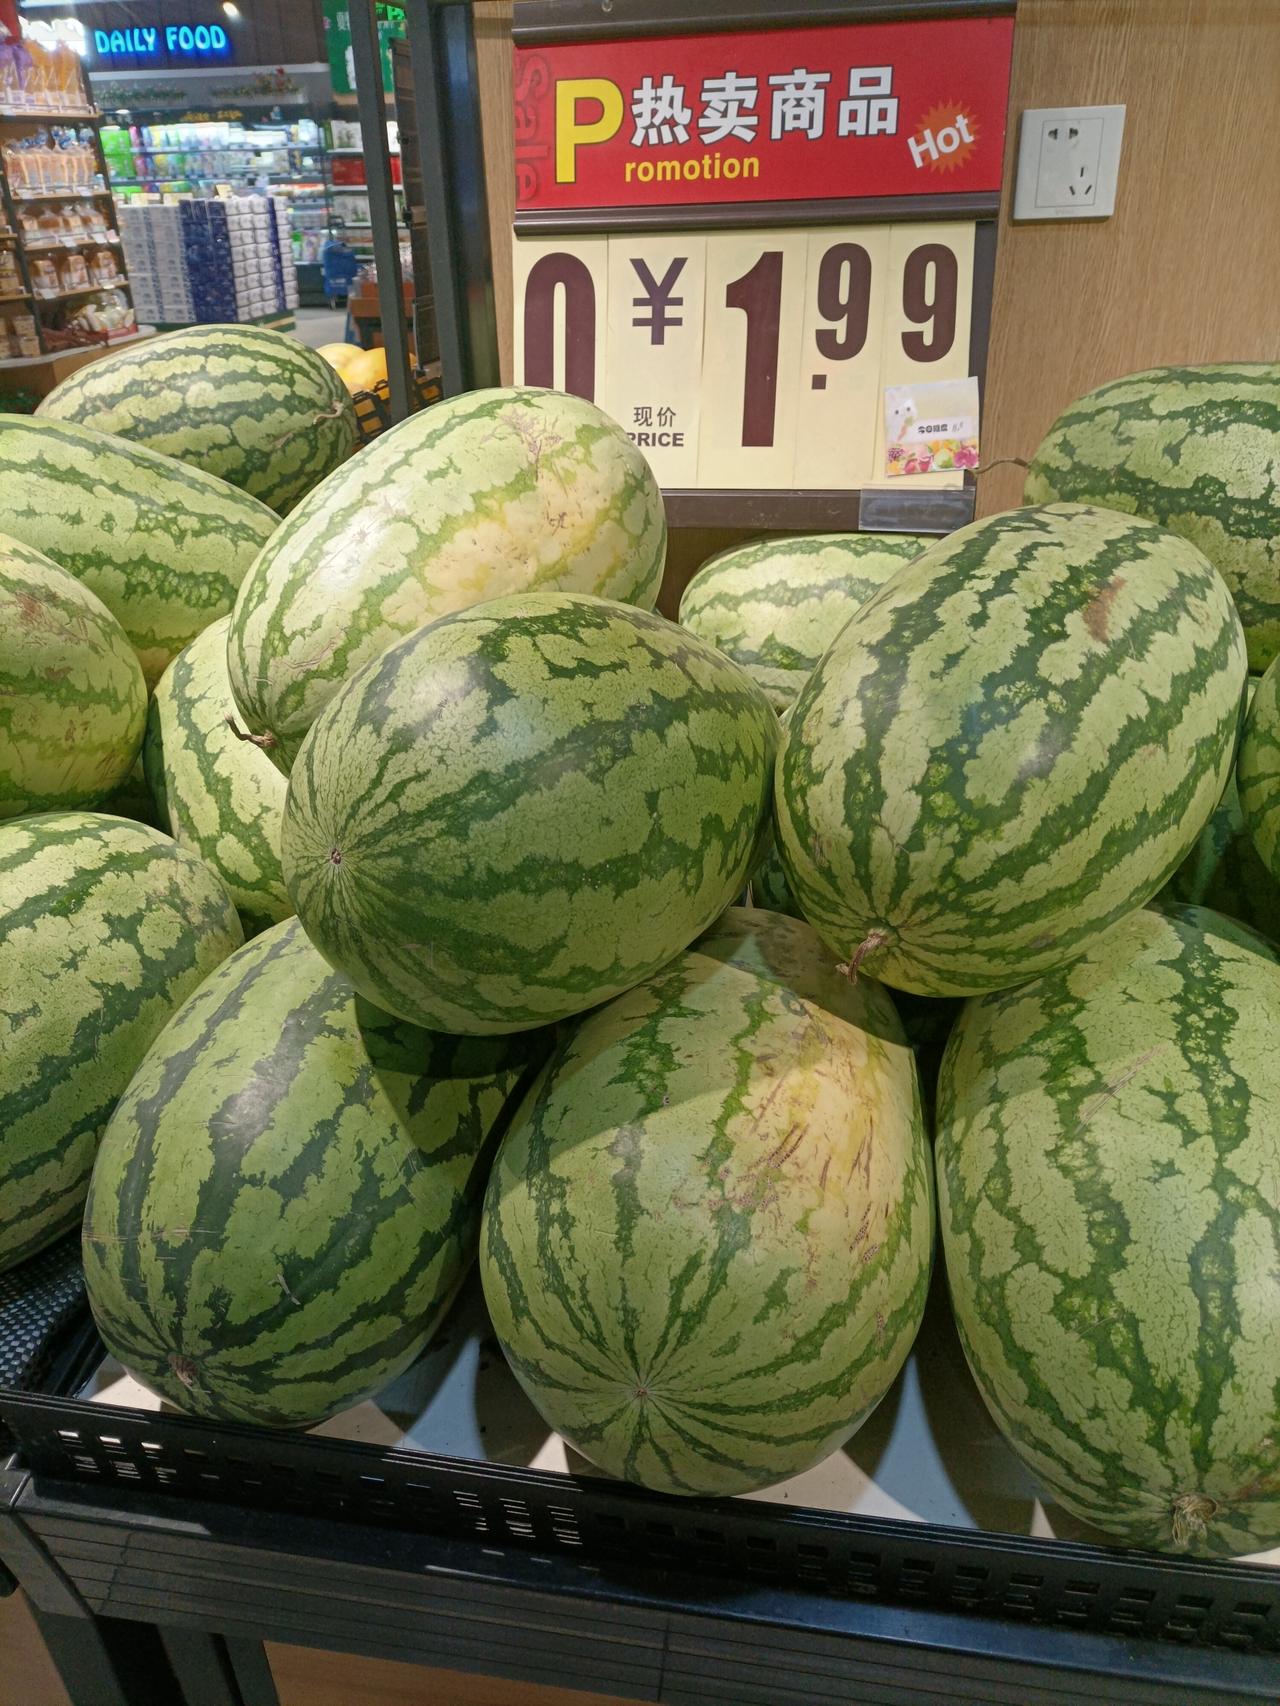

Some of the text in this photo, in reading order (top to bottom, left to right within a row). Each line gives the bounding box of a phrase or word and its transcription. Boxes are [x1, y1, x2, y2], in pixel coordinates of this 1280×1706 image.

[94, 27, 156, 53] DAILY
[165, 25, 226, 50] FOOD
[630, 66, 899, 147] 热卖商品
[907, 113, 975, 169] Hot
[633, 406, 676, 427] 现价
